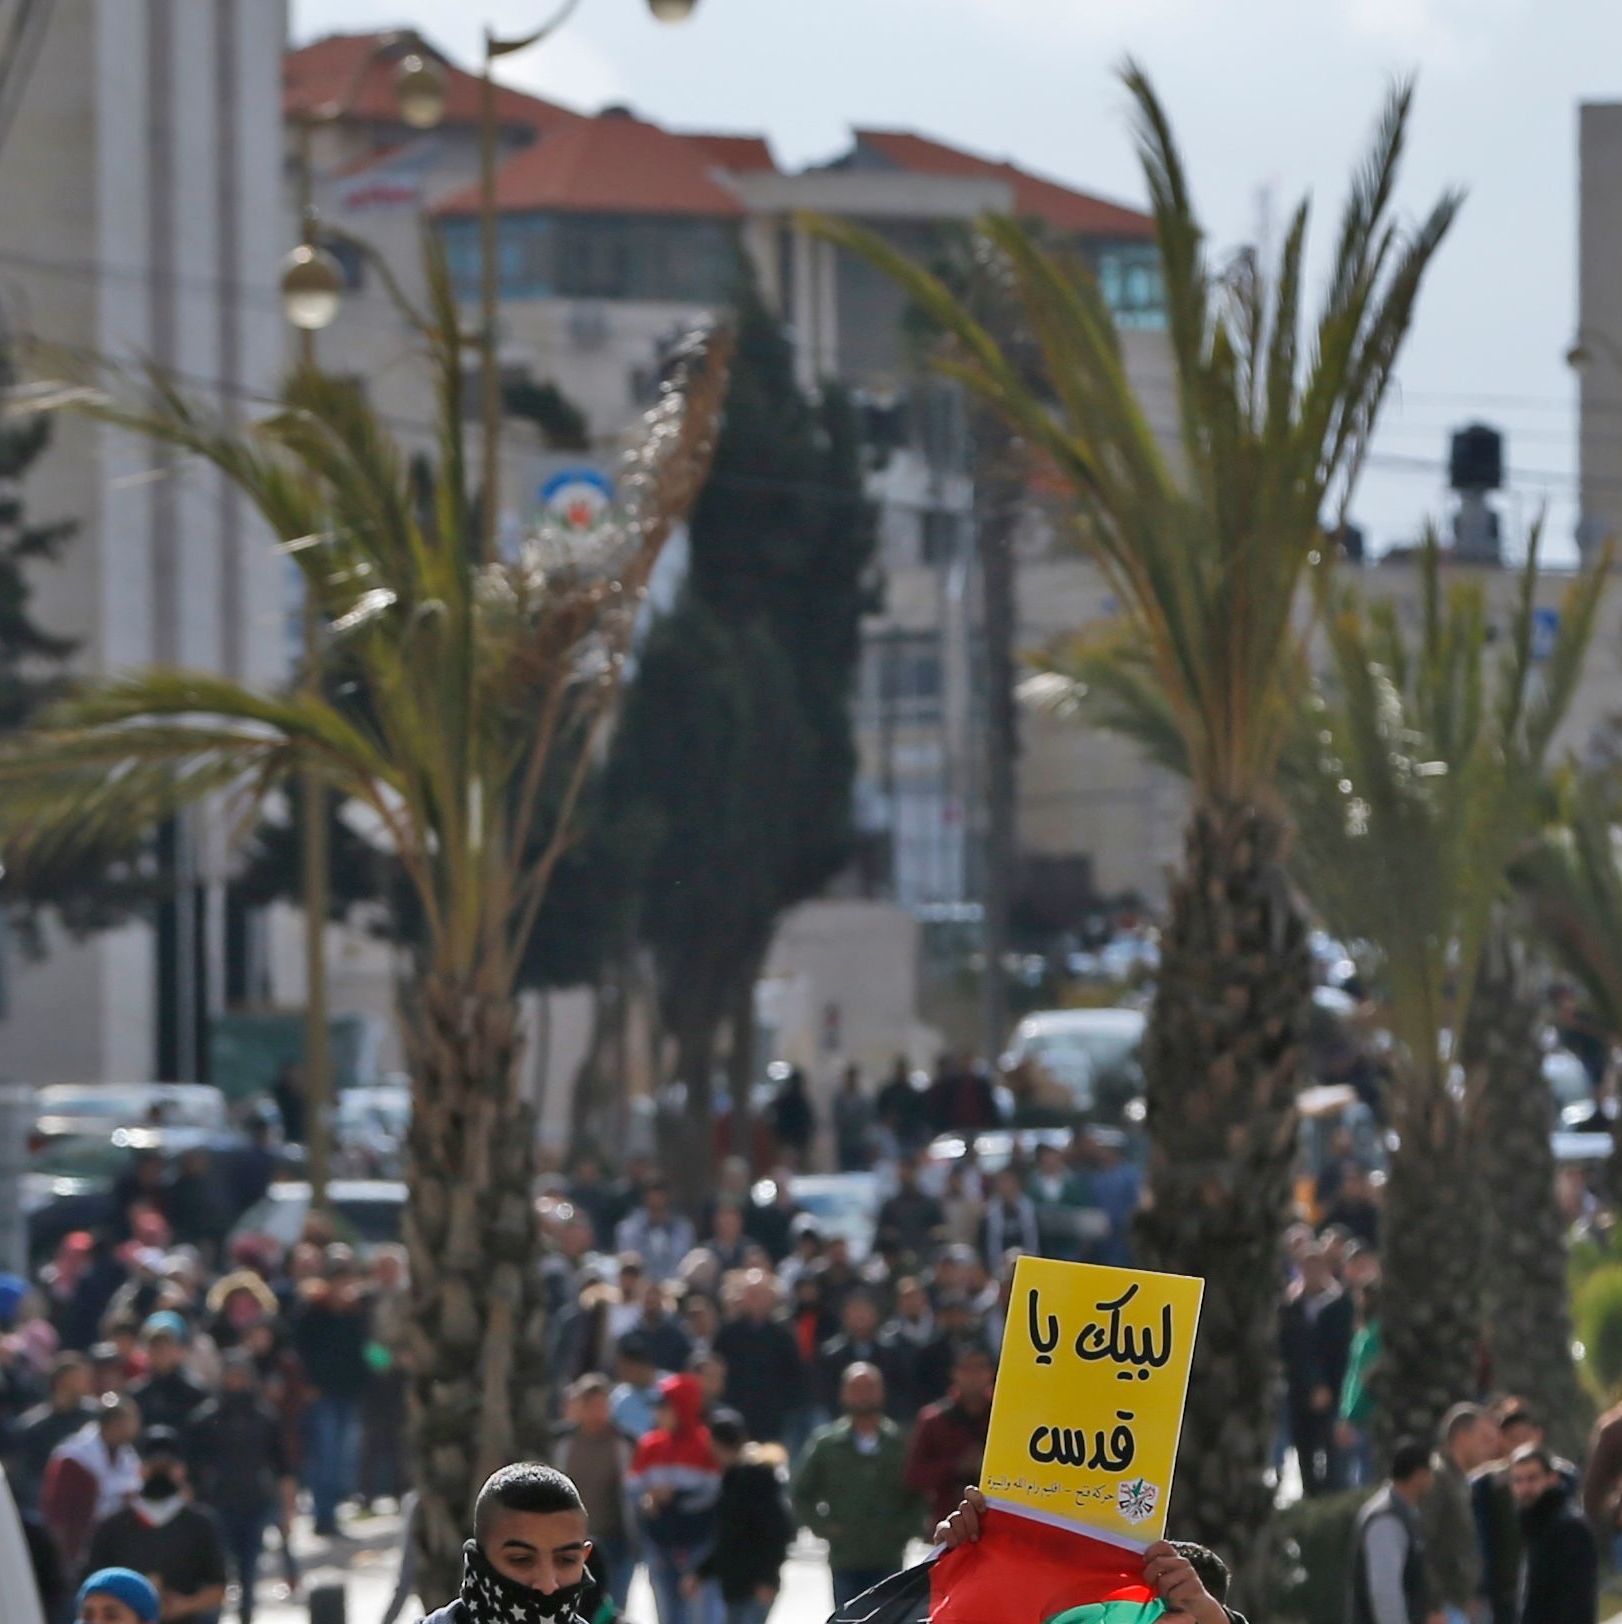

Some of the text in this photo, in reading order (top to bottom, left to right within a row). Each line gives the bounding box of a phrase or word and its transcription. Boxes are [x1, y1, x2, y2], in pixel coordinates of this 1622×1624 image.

[1029, 1283, 1172, 1381] لبيك يا
[1029, 1410, 1135, 1473] قدس
